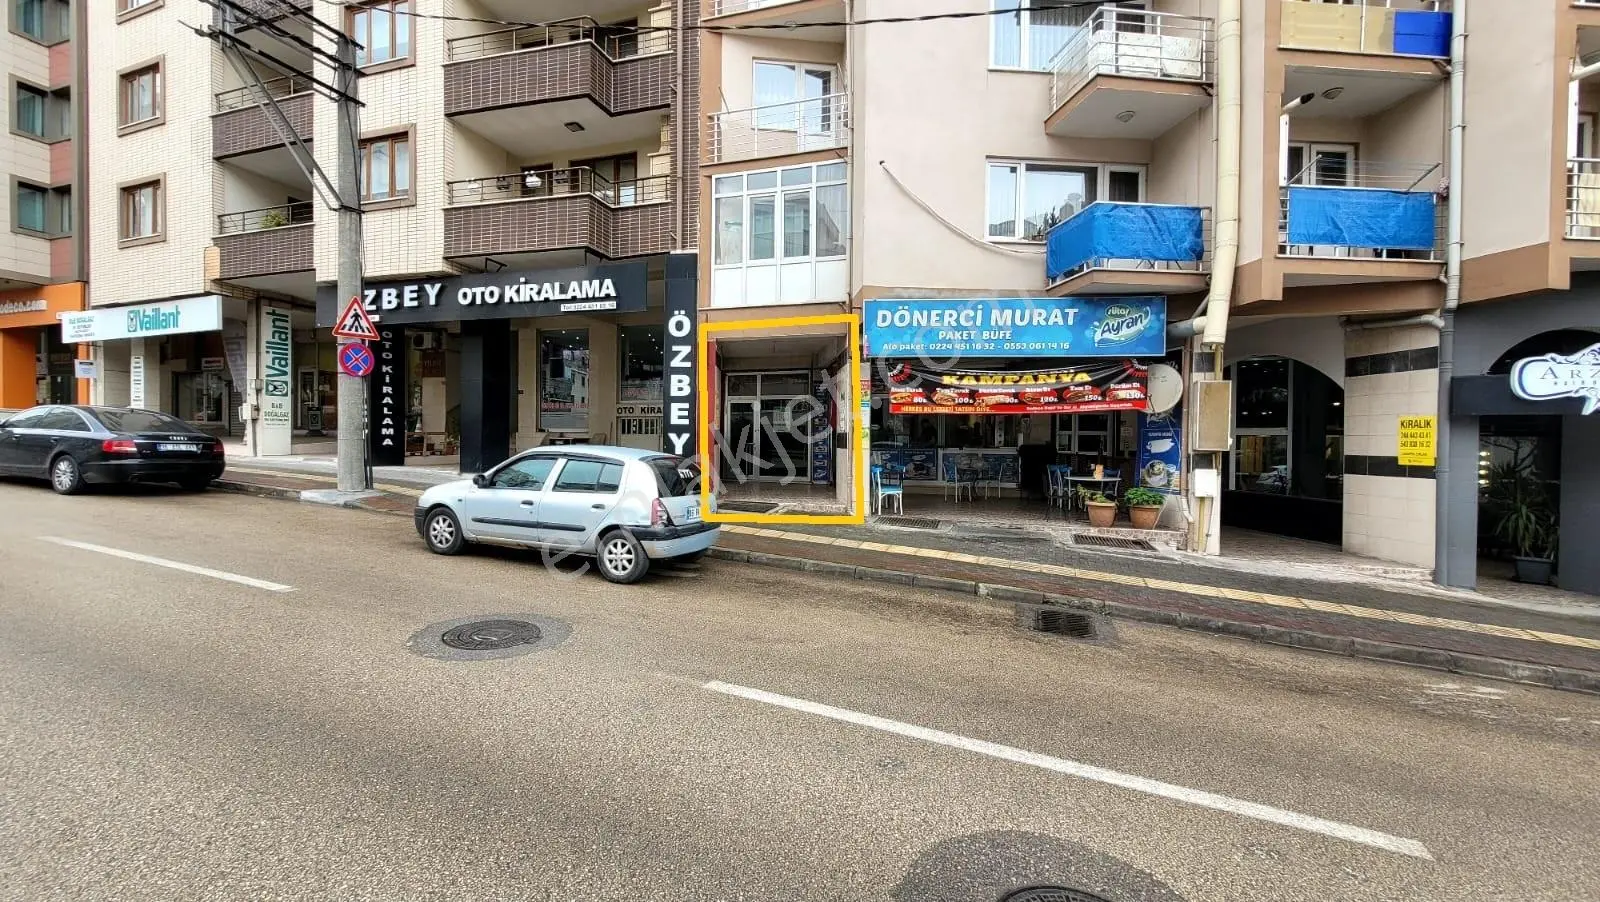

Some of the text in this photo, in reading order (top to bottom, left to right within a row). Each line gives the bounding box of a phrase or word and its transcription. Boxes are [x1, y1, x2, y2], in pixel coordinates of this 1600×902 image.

[361, 277, 616, 311] ZBEY OTO KİRALAMA
[138, 304, 181, 332] Vaillant
[876, 305, 1078, 327] DÖNERCİ MURAT
[1100, 314, 1143, 337] Ayran
[265, 309, 289, 378] Vaillant
[938, 329, 1012, 340] PAKET BÜFE
[381, 331, 394, 446] OTO KİRALAMA
[668, 310, 692, 455] ÖZBEY
[942, 373, 1092, 385] KAMPANYA
[641, 406, 662, 414] KIRA
